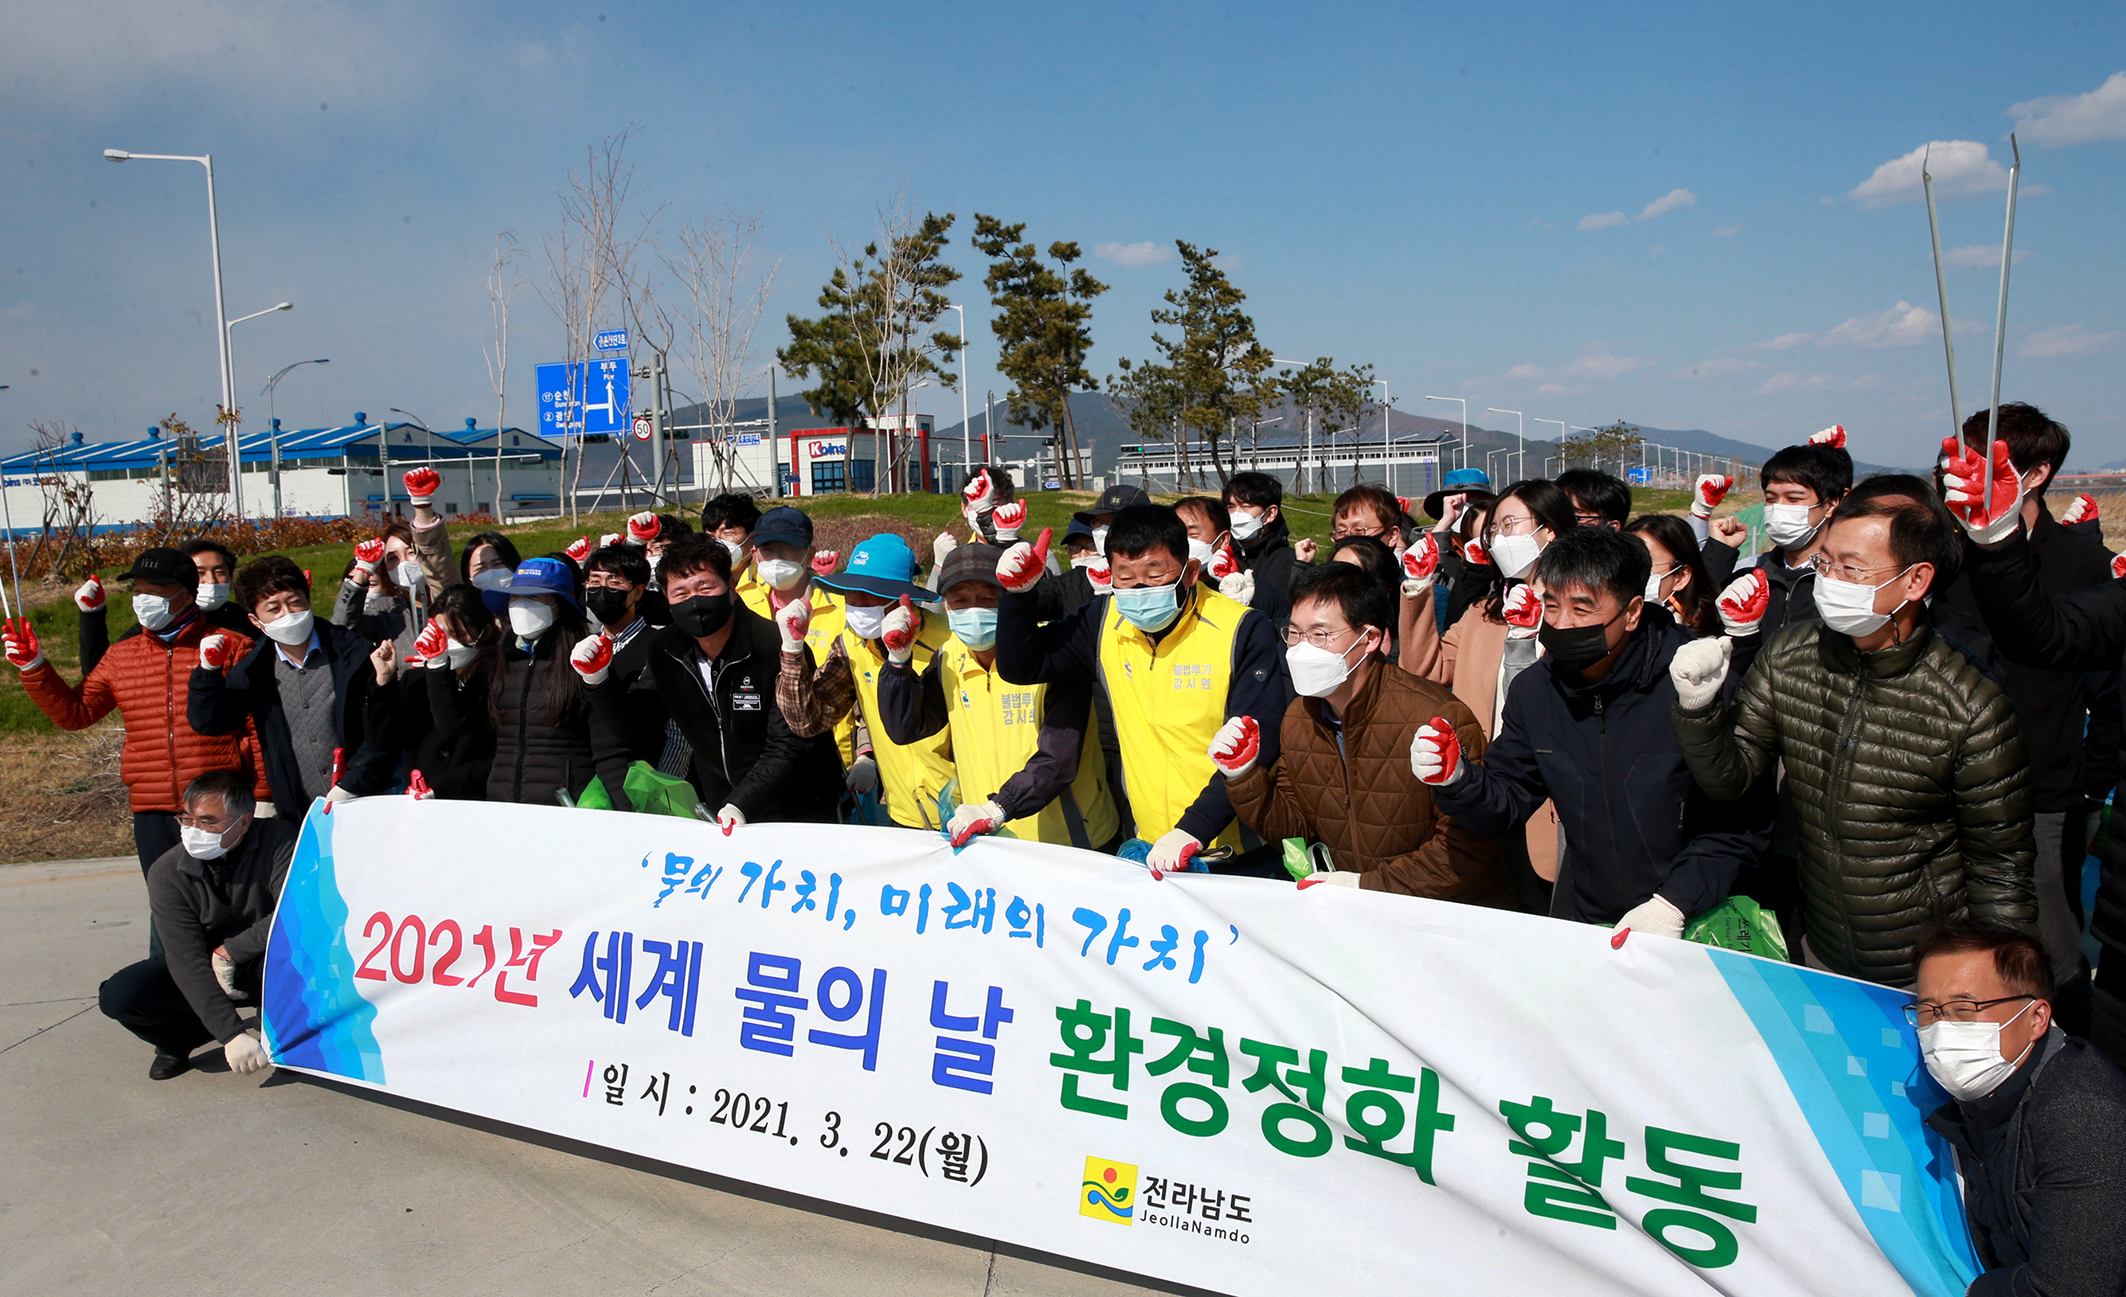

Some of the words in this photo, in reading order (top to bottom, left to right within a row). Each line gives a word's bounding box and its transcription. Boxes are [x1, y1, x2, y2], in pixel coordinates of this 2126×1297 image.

[513, 435, 520, 446] B
[637, 423, 649, 435] 50
[809, 441, 846, 457] Koins
[1173, 664, 1212, 676] 불법투기
[738, 859, 856, 931] 가치,
[881, 882, 1045, 948] 미래의
[354, 911, 563, 1008] 2021년
[569, 931, 703, 1037] 세계
[735, 951, 887, 1072] 물의
[930, 979, 1014, 1095] 날
[1049, 998, 1455, 1187] 환경정화
[1499, 1095, 1757, 1269] 활동
[709, 1088, 799, 1147] 2021.
[820, 1111, 848, 1158] 3.
[870, 1121, 989, 1187] 22(월)
[1142, 1175, 1253, 1224] 전라남도
